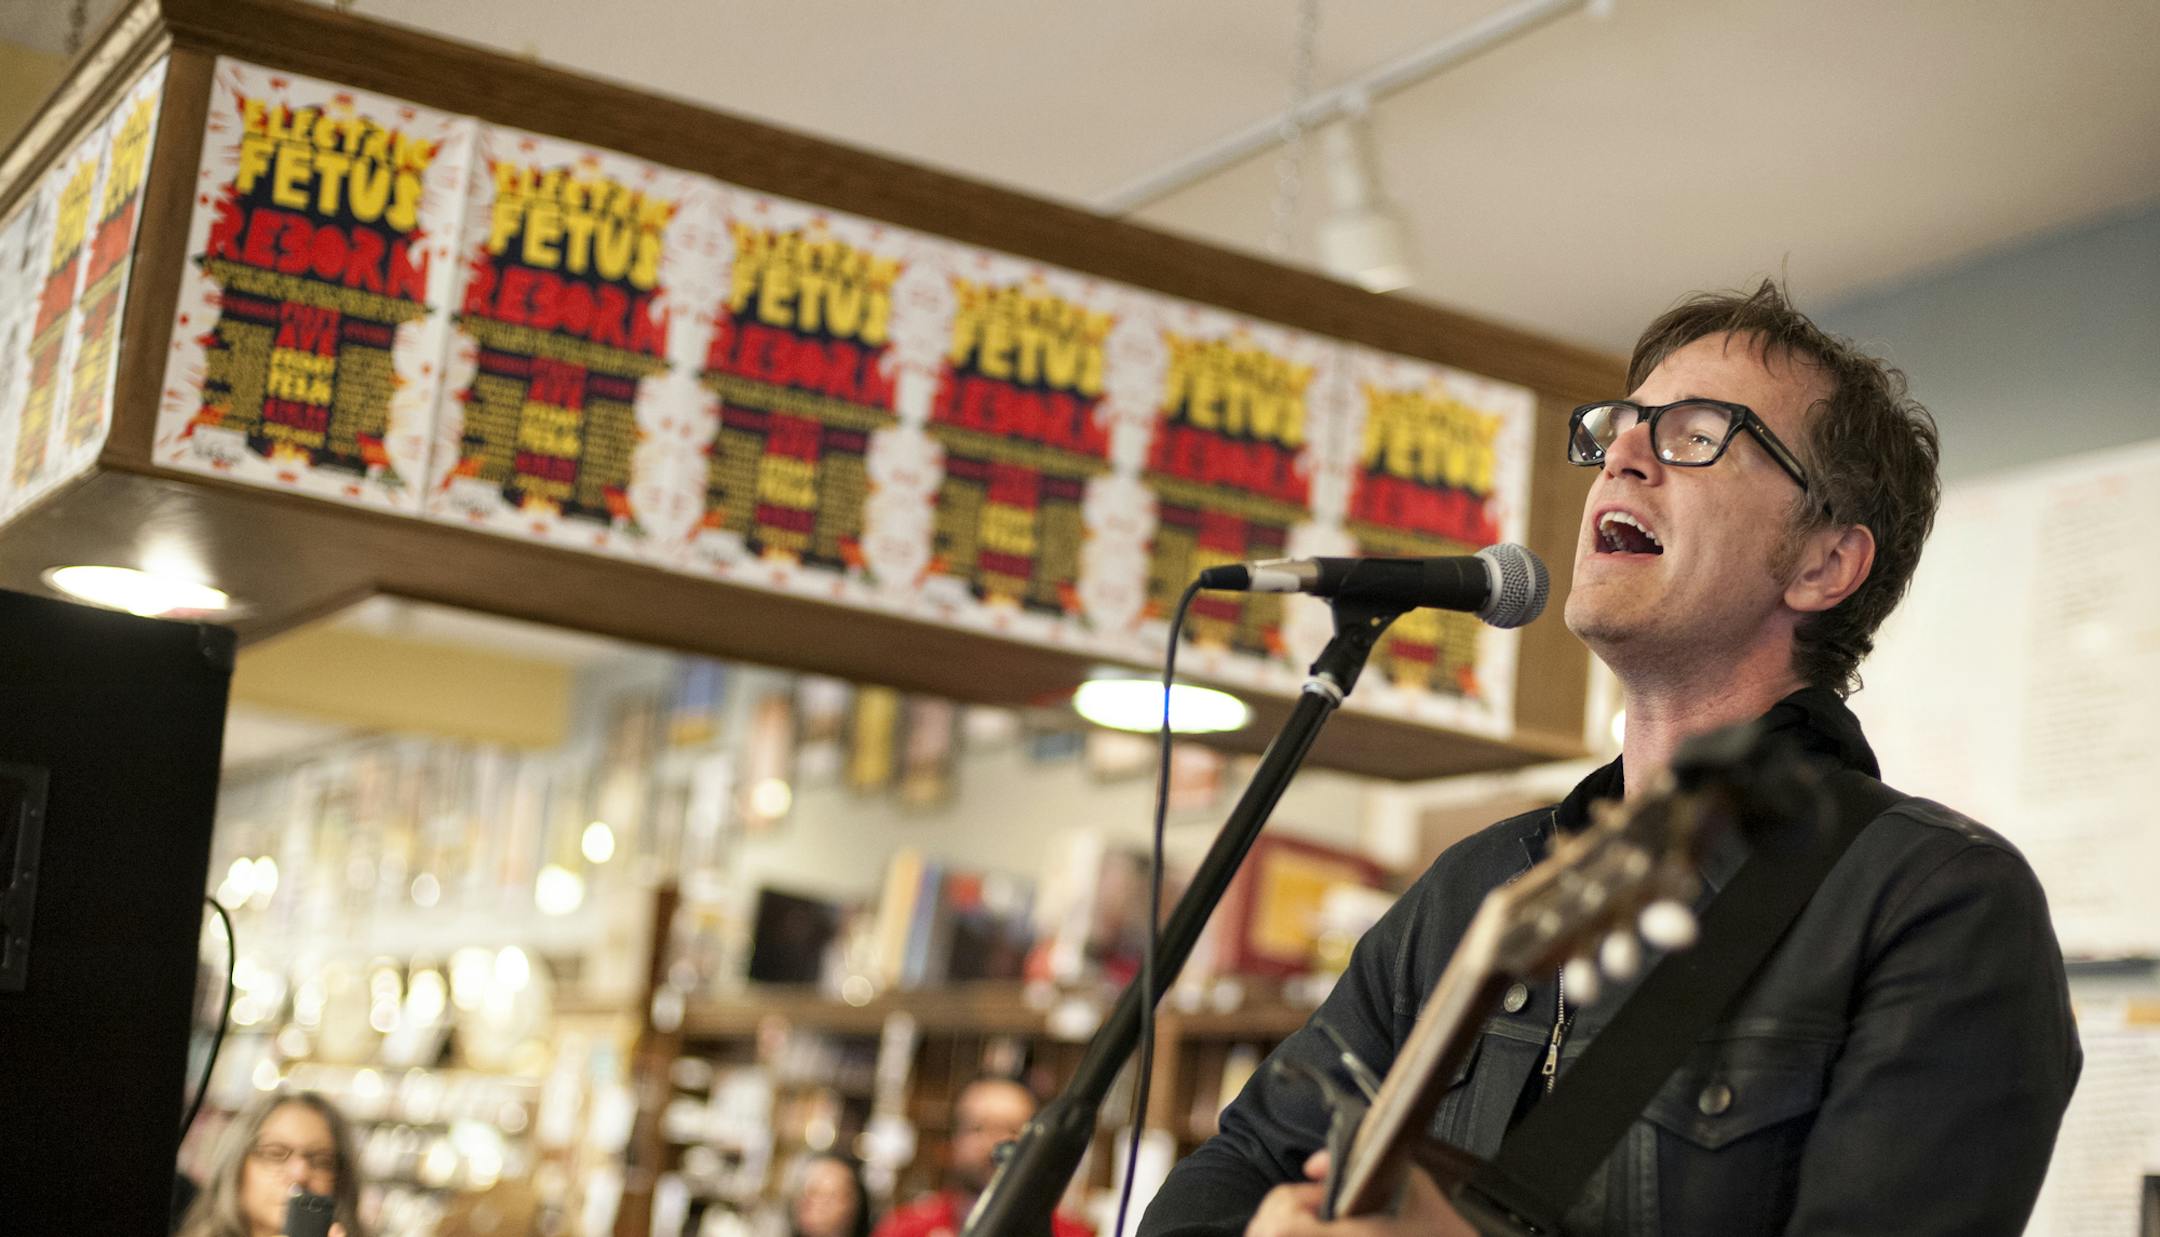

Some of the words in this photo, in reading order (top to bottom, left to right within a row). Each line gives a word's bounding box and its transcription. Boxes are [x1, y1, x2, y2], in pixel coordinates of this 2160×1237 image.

[235, 138, 423, 231] FETUS
[206, 206, 430, 304] REBORN
[489, 199, 664, 291] FETUS
[463, 261, 668, 360] REBORN
